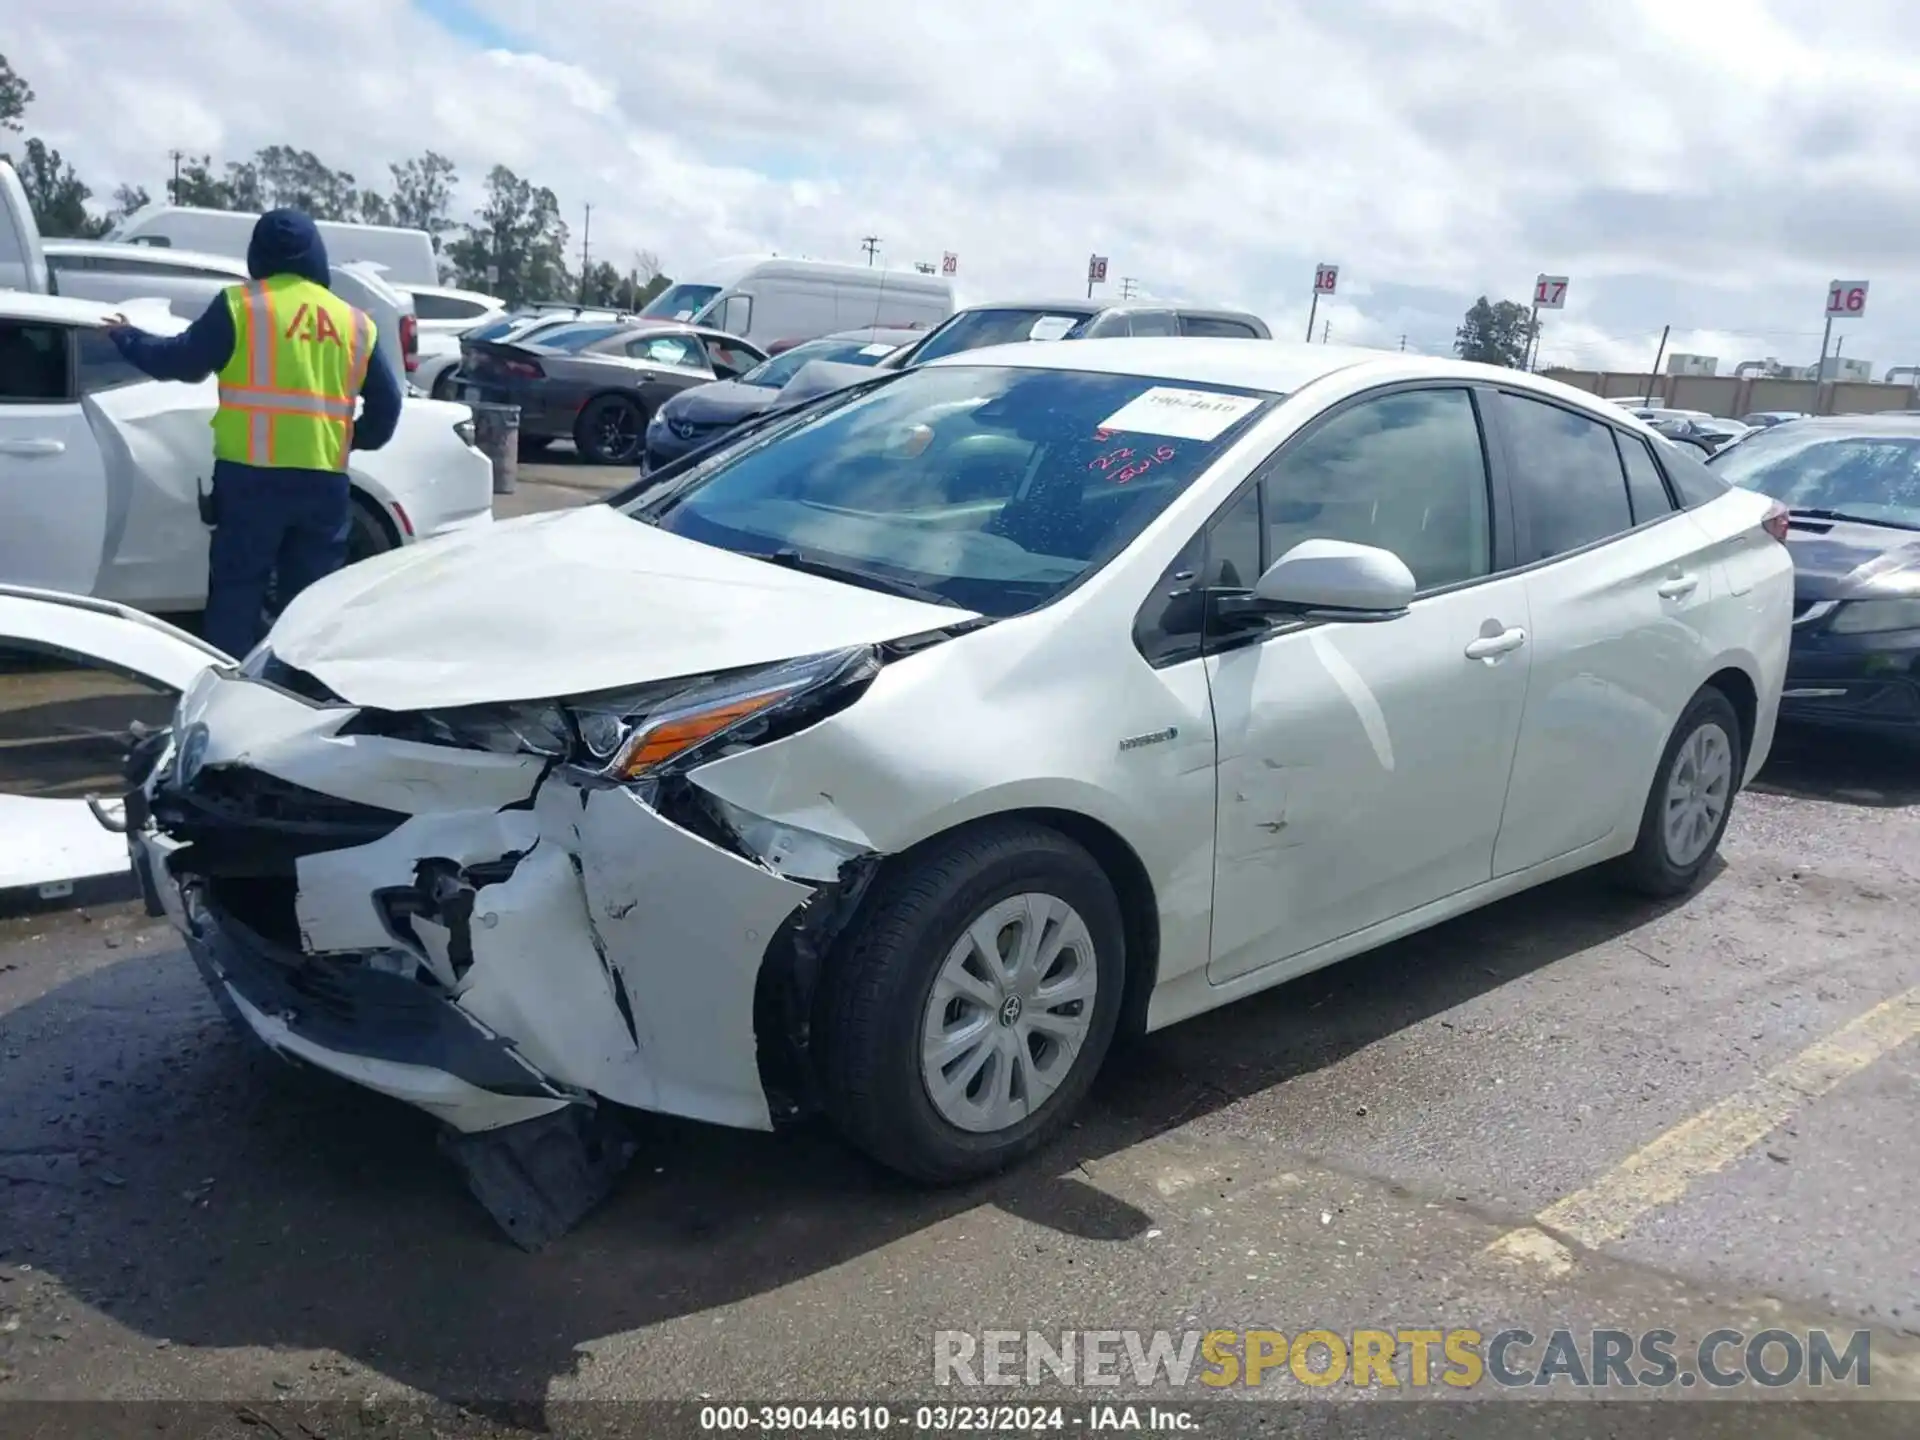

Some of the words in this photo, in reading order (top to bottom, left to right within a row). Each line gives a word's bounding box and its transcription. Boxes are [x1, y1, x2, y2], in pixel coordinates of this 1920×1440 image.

[943, 256, 957, 273] 20
[1090, 262, 1106, 278] 19
[1316, 271, 1337, 289] 18
[1536, 282, 1568, 303] 17
[1827, 287, 1865, 311] 16
